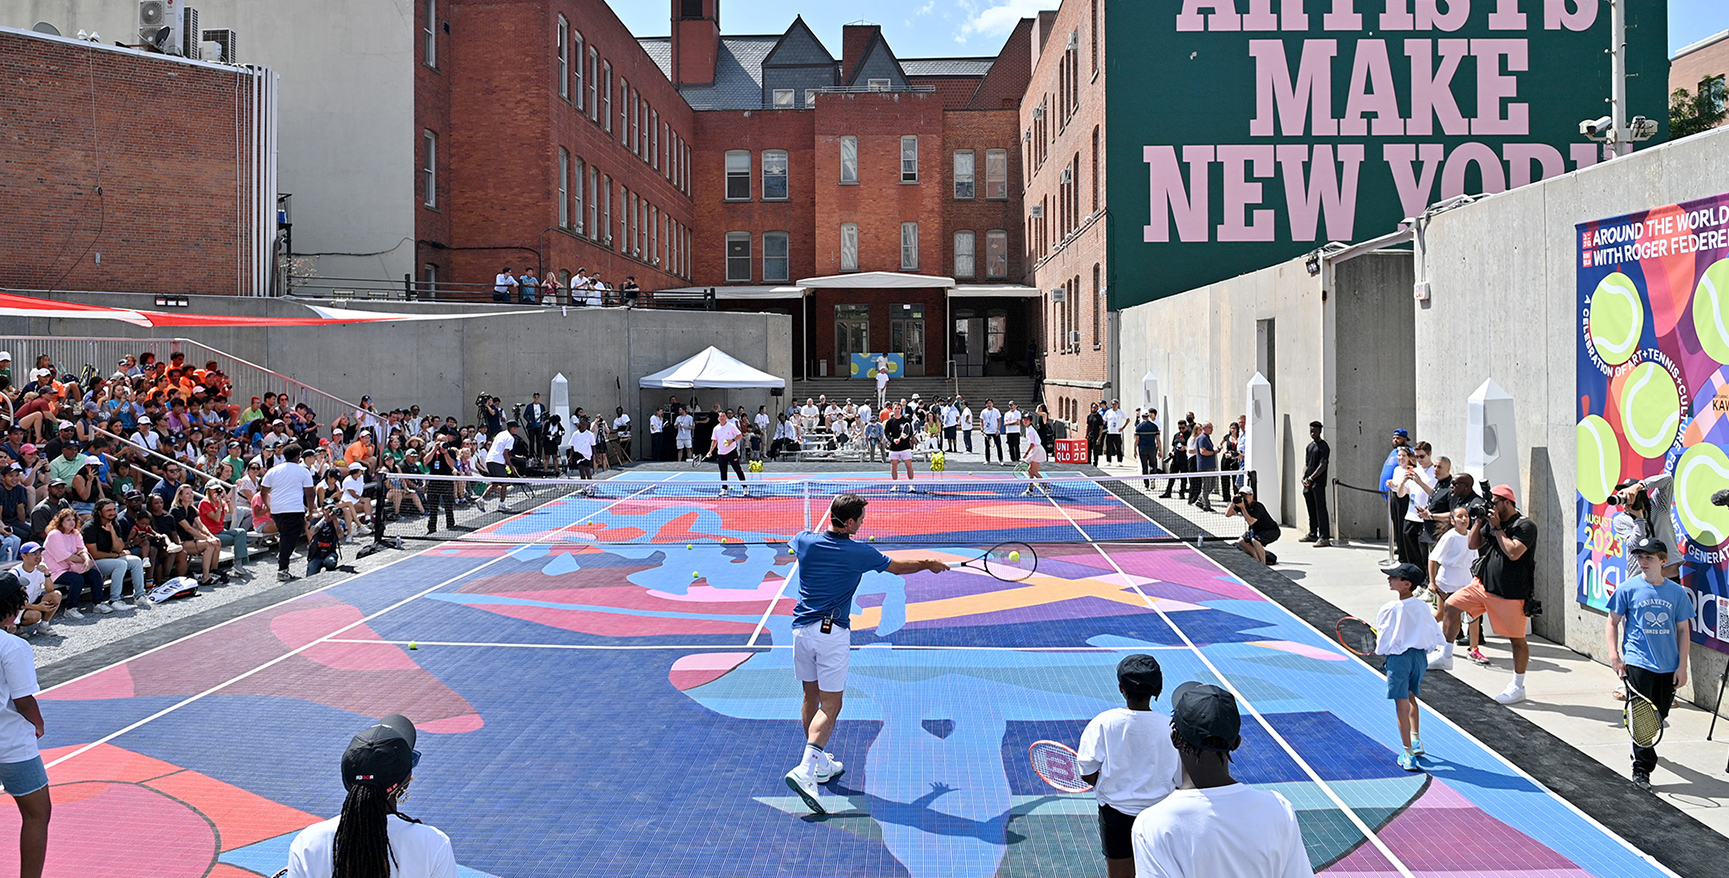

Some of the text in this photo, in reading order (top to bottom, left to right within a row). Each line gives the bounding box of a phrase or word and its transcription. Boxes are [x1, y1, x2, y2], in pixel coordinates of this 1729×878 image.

[1248, 38, 1529, 137] MAKE
[1143, 142, 1631, 243] NEW YO
[1593, 205, 1729, 247] AROUND THE WORLD
[1593, 228, 1729, 267] WITH ROGER FEDERE
[1584, 294, 1591, 304] A
[1583, 308, 1614, 378] CELEBRATION
[1615, 365, 1628, 378] OF
[1056, 442, 1070, 451] UNI
[1056, 452, 1071, 462] QLO
[1584, 513, 1613, 528] AUGUST
[1584, 526, 1623, 558] 2023
[1639, 599, 1673, 610] LAFAYETTE
